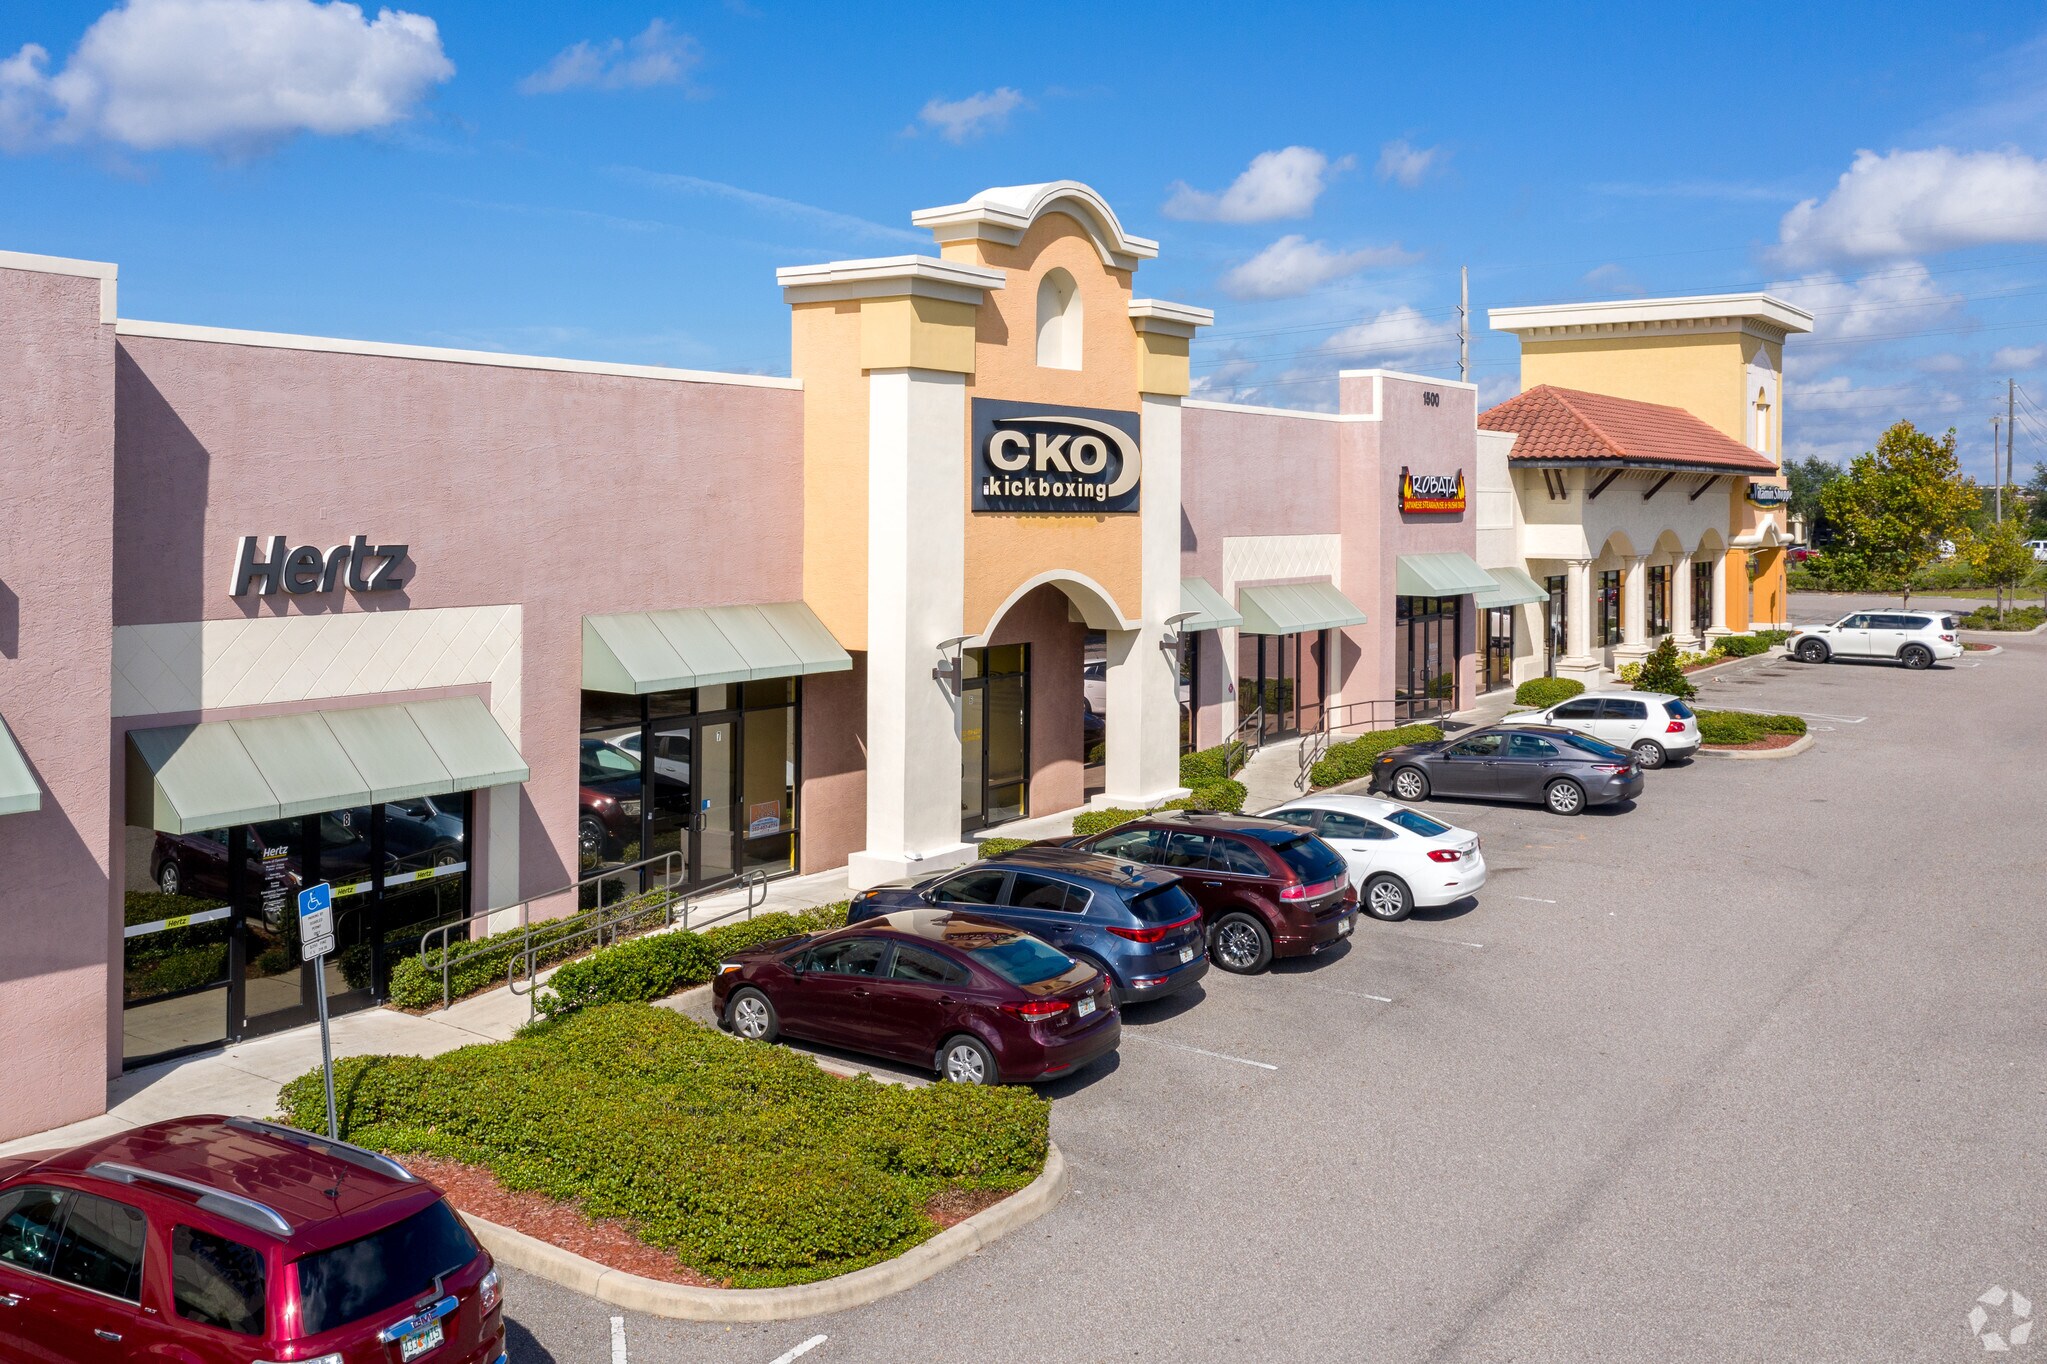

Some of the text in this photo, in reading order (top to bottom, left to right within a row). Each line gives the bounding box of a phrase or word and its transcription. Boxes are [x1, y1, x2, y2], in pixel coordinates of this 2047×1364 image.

[1422, 391, 1440, 408] 1500
[988, 429, 1108, 475] CKO
[989, 474, 1107, 502] kickboxing
[1412, 475, 1457, 497] ROBATA
[229, 535, 409, 596] Hertz
[344, 813, 350, 826] 8
[263, 845, 289, 858] Hertz
[337, 887, 353, 895] Hertz
[168, 918, 187, 927] Hertz
[411, 1310, 439, 1328] GMC
